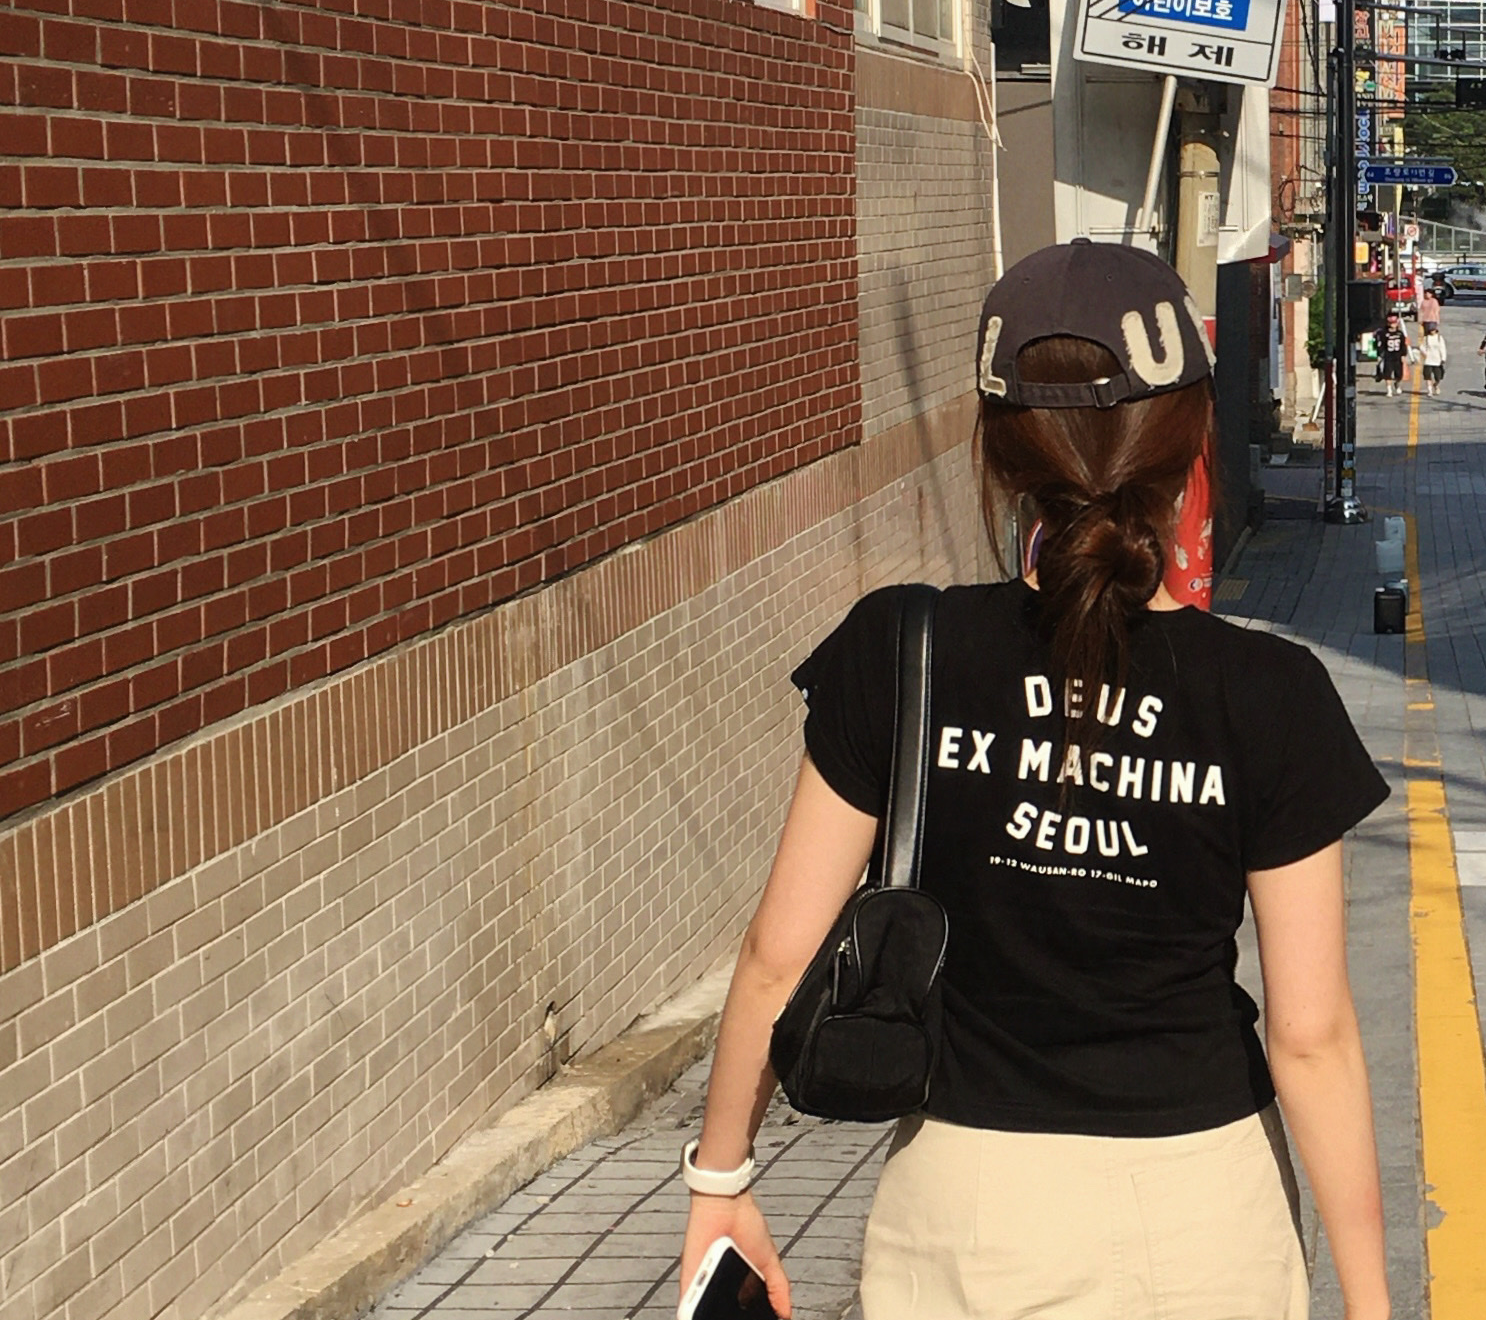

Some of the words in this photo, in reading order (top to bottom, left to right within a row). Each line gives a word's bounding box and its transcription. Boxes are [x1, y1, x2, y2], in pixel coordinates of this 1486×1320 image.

[1024, 675, 1164, 738] DEUS
[937, 726, 996, 774] EX
[1017, 738, 1226, 806] MACHINA
[1005, 801, 1149, 858] SEOUL
[1125, 875, 1159, 889] MAPO
